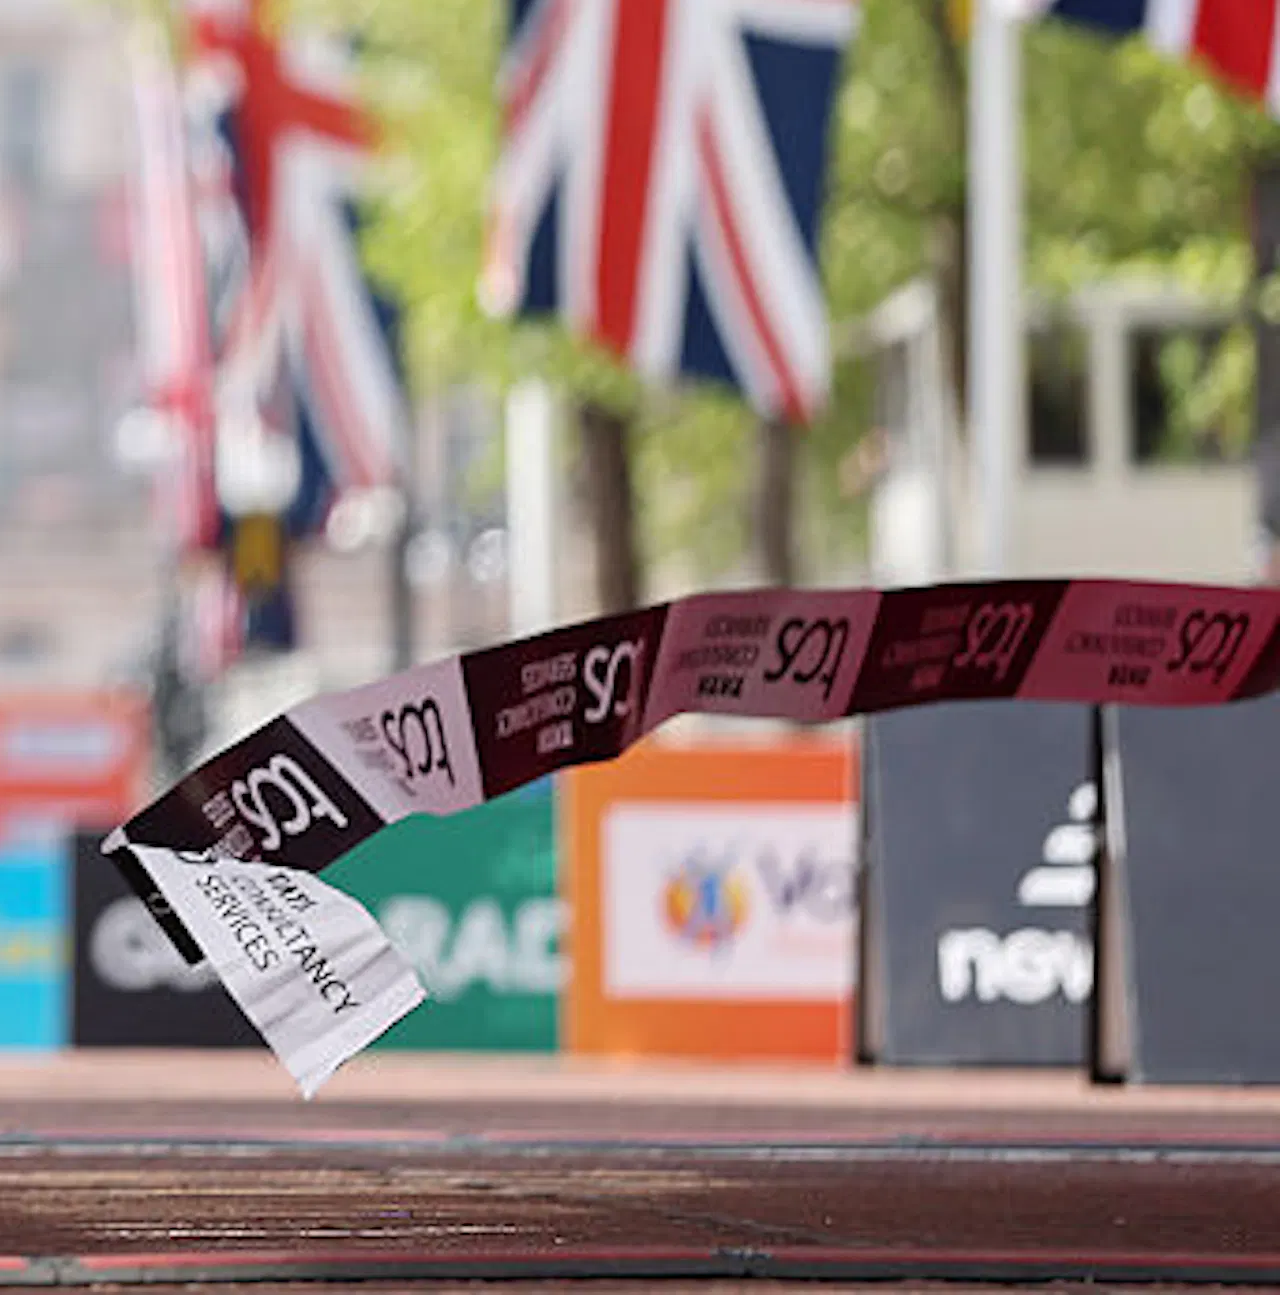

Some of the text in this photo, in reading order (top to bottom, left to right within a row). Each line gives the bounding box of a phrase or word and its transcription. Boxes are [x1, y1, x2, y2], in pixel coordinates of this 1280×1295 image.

[762, 615, 851, 702] tcs
[1166, 608, 1251, 685] tcs
[380, 697, 456, 788] tcs
[231, 754, 349, 852] tcs
[196, 873, 280, 973] SERVICES
